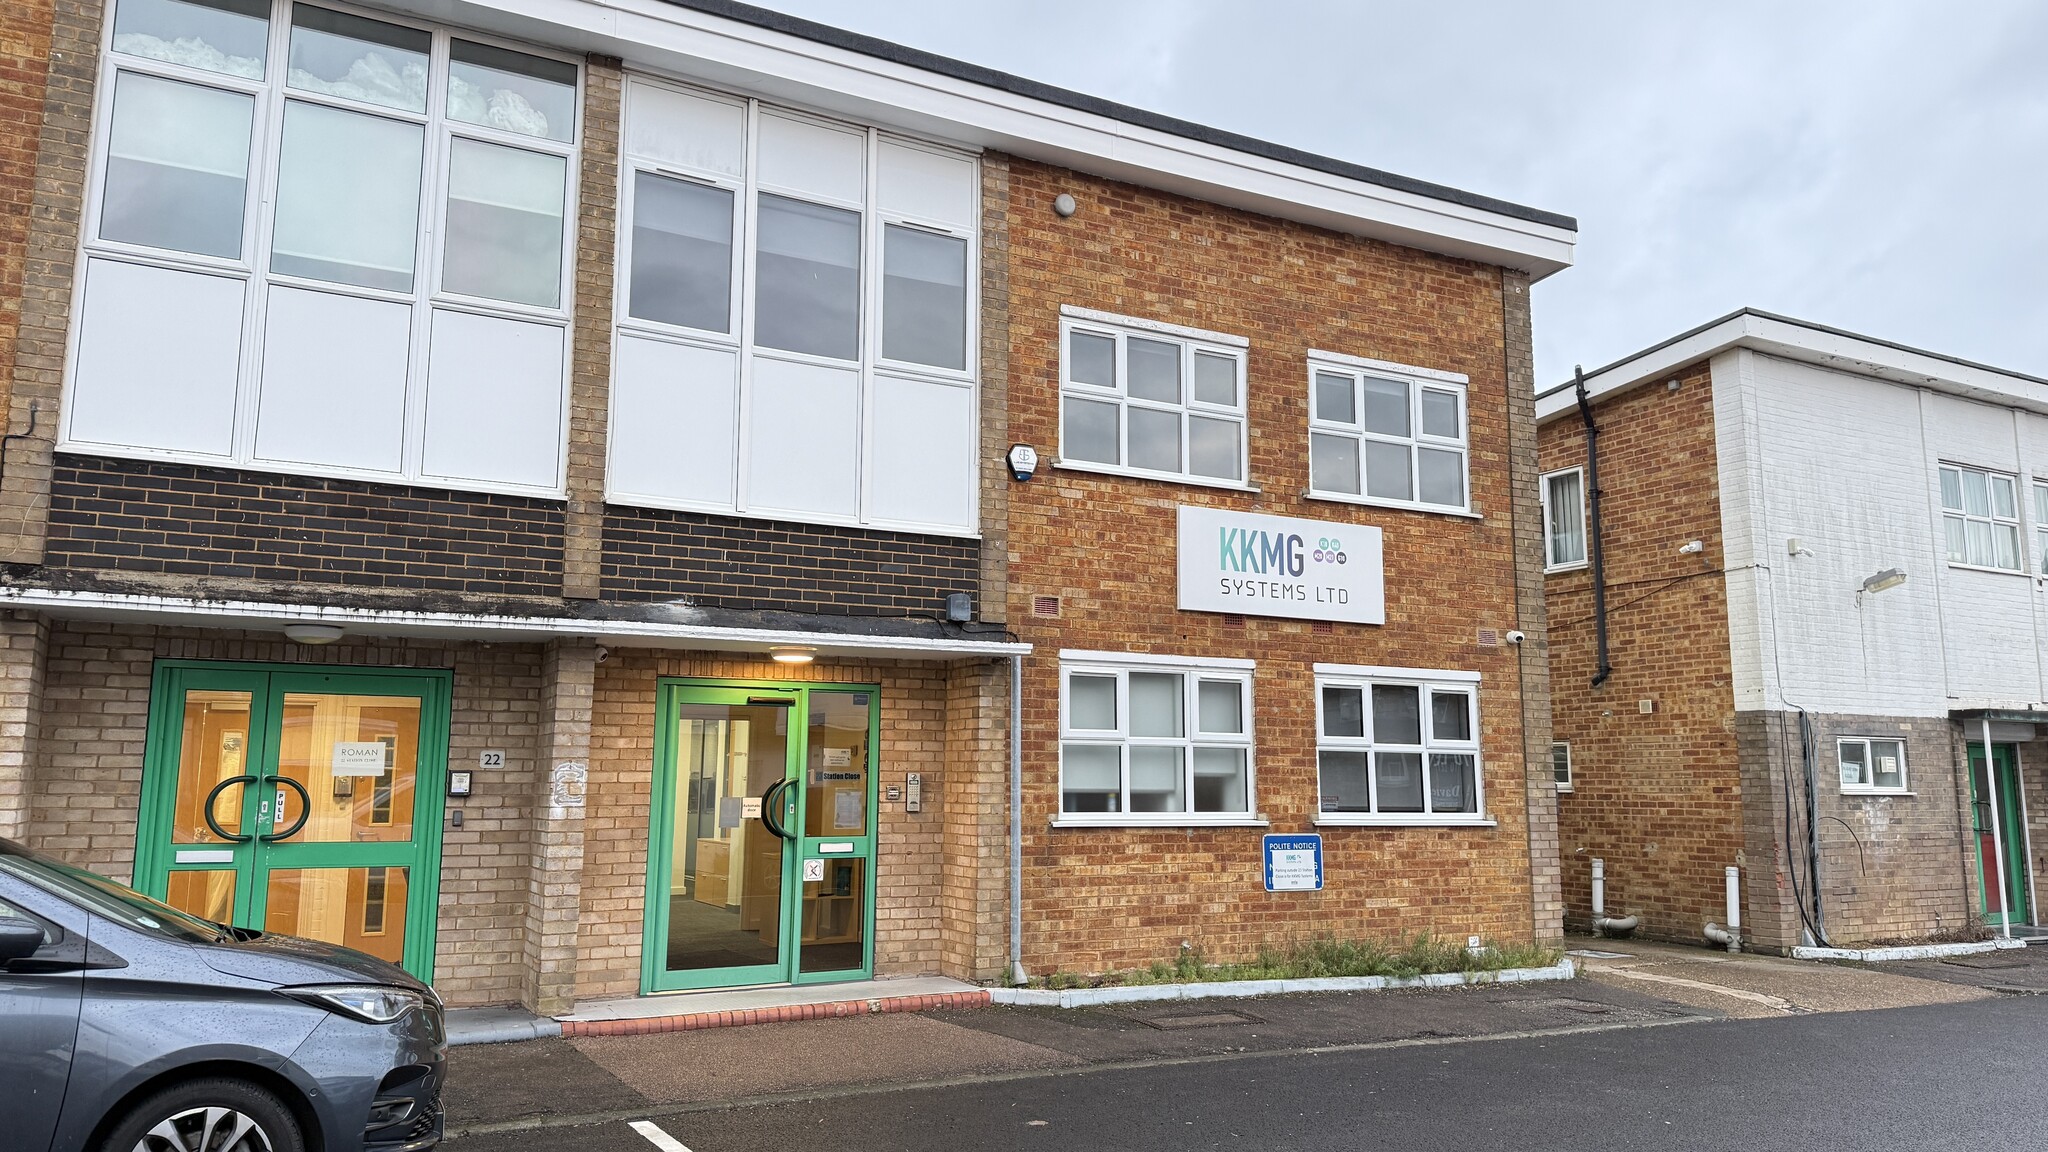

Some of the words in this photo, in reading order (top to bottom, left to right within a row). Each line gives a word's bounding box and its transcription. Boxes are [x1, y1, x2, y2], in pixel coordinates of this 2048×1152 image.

[1220, 527, 1304, 577] KKMG
[1220, 579, 1306, 601] SYSTEMS
[1316, 586, 1349, 604] LTD
[341, 748, 379, 756] ROMAN
[484, 754, 500, 765] 22
[823, 772, 844, 780] Station
[845, 772, 861, 780] Close
[1269, 842, 1291, 850] POLITE
[1293, 842, 1317, 850] NOTICE
